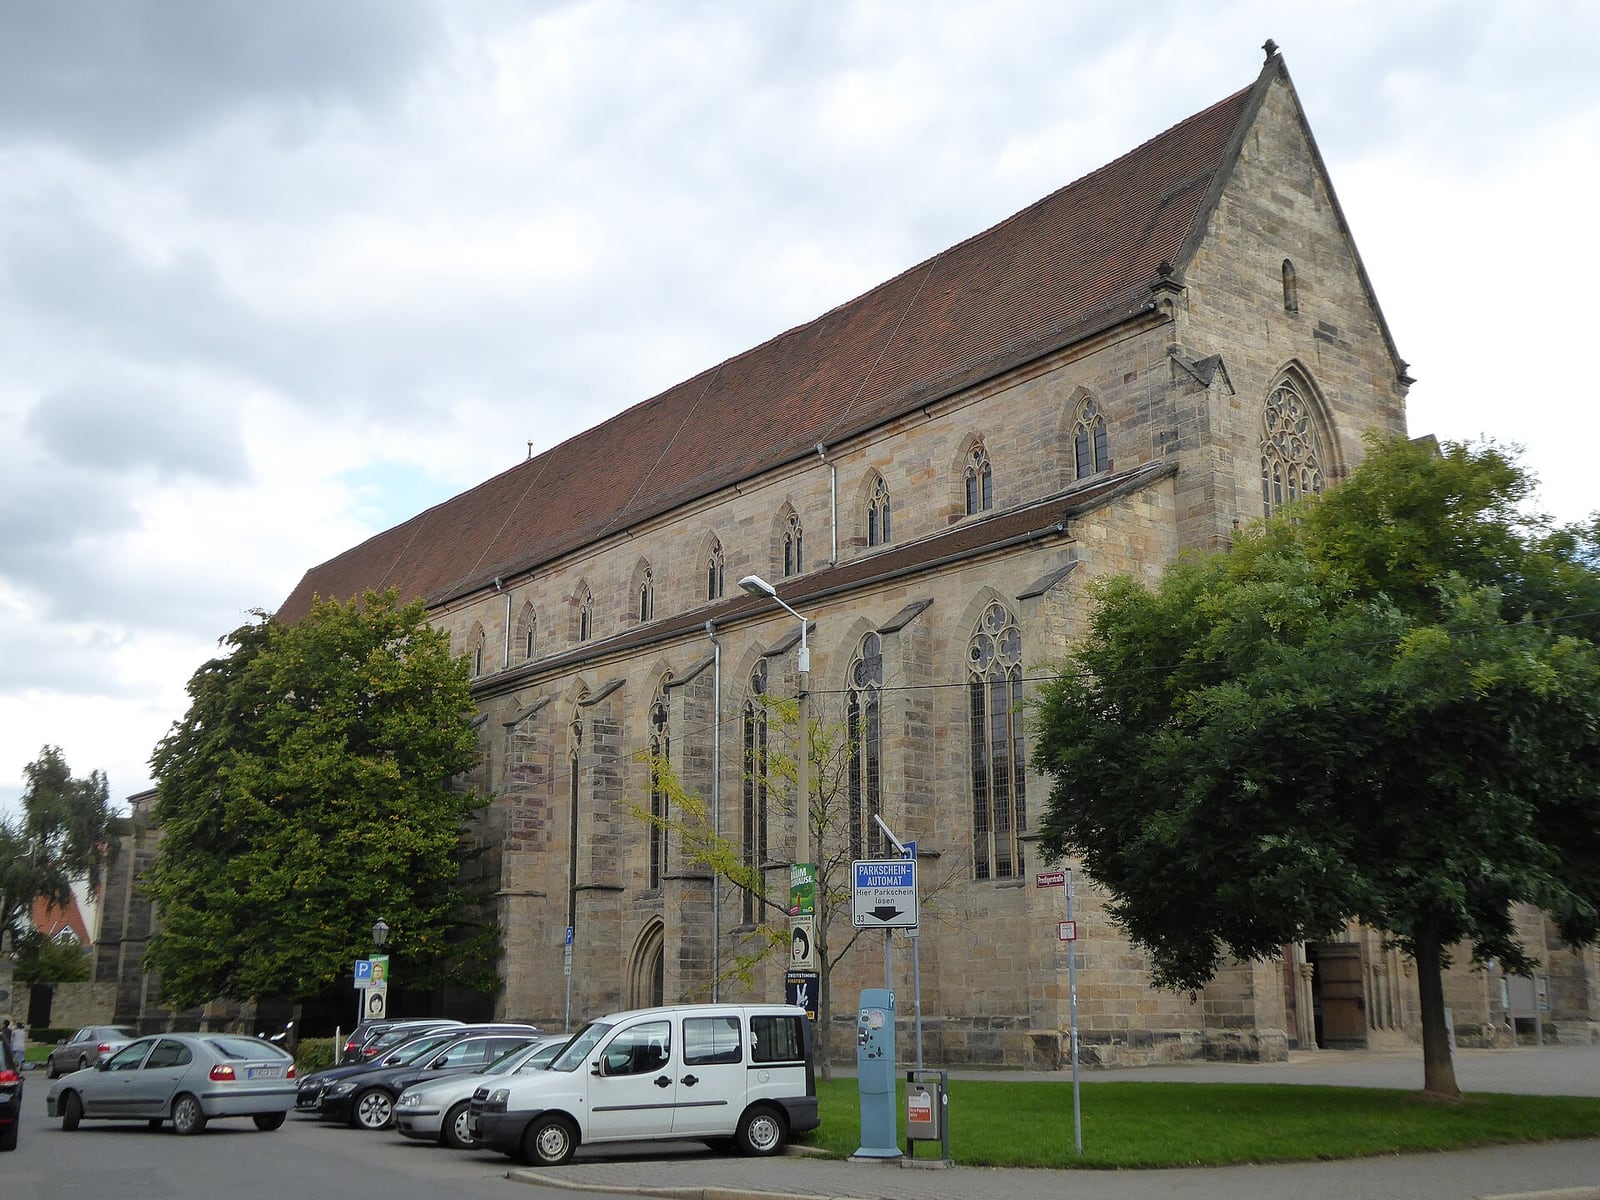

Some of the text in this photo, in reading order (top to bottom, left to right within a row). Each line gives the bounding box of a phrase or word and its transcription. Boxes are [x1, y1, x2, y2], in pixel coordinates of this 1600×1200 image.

[859, 865, 911, 876] PARKSCHEIN-
[867, 876, 903, 886] AUTOMAT
[874, 888, 914, 896] Parkschein
[856, 915, 865, 923] 33
[359, 962, 369, 977] P
[890, 993, 895, 1008] P
